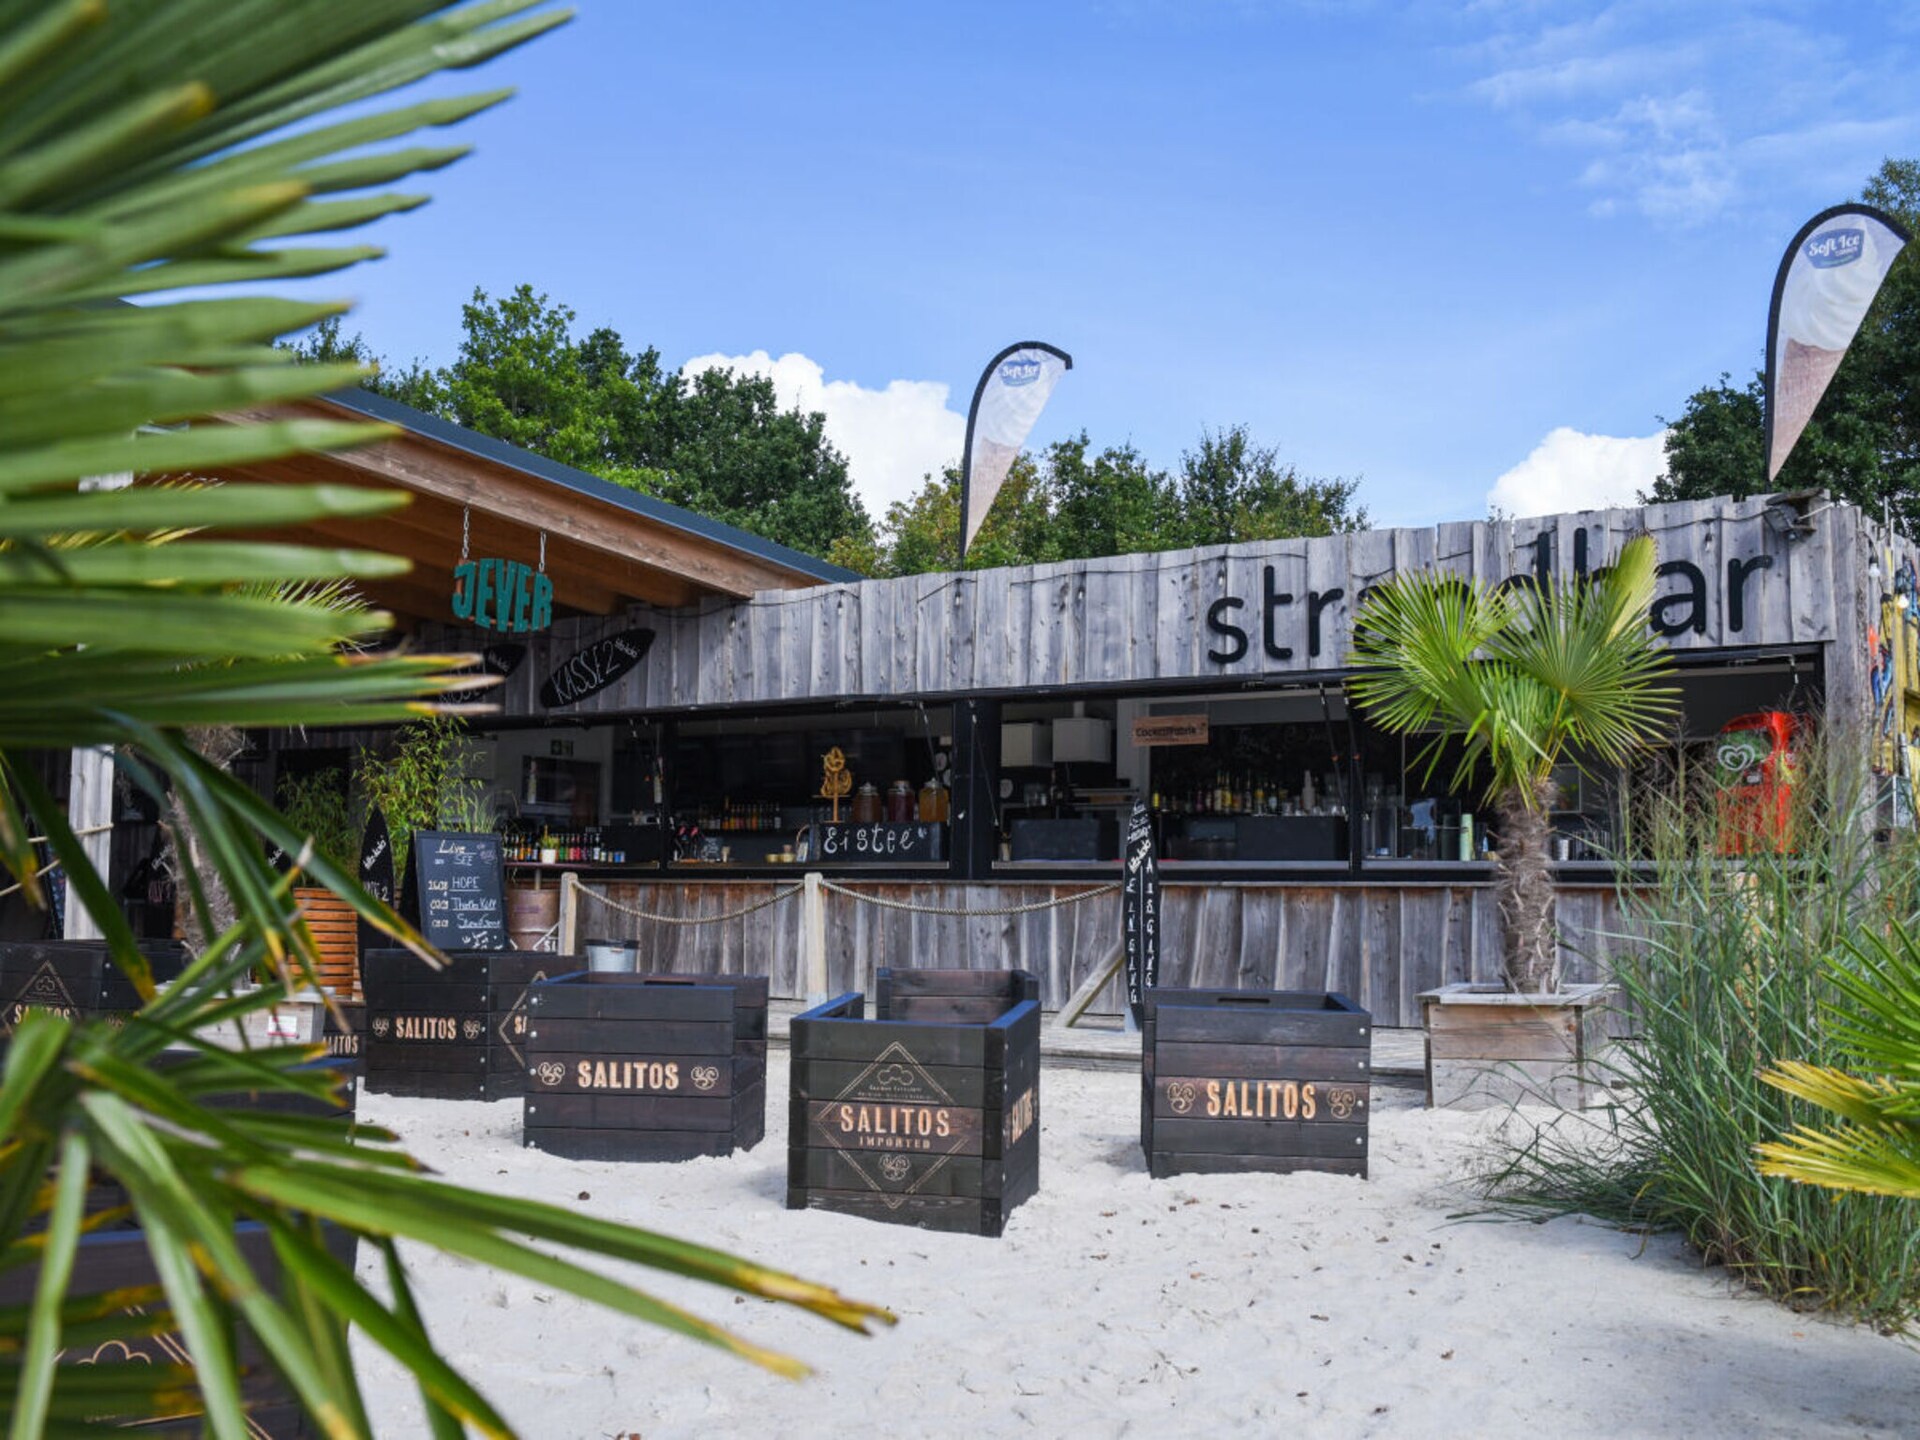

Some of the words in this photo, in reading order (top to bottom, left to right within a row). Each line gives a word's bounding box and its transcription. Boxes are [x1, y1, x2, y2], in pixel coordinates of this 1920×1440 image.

[1808, 238, 1837, 257] Soft
[1838, 234, 1860, 249] Ice
[452, 557, 554, 633] JEVER
[602, 640, 621, 674] 2
[395, 1016, 456, 1040] SALITOS
[577, 1060, 680, 1090] SALITOS
[1206, 1080, 1317, 1119] SALITOS
[840, 1104, 950, 1137] SALITOS
[859, 1136, 931, 1149] IMPORTED
